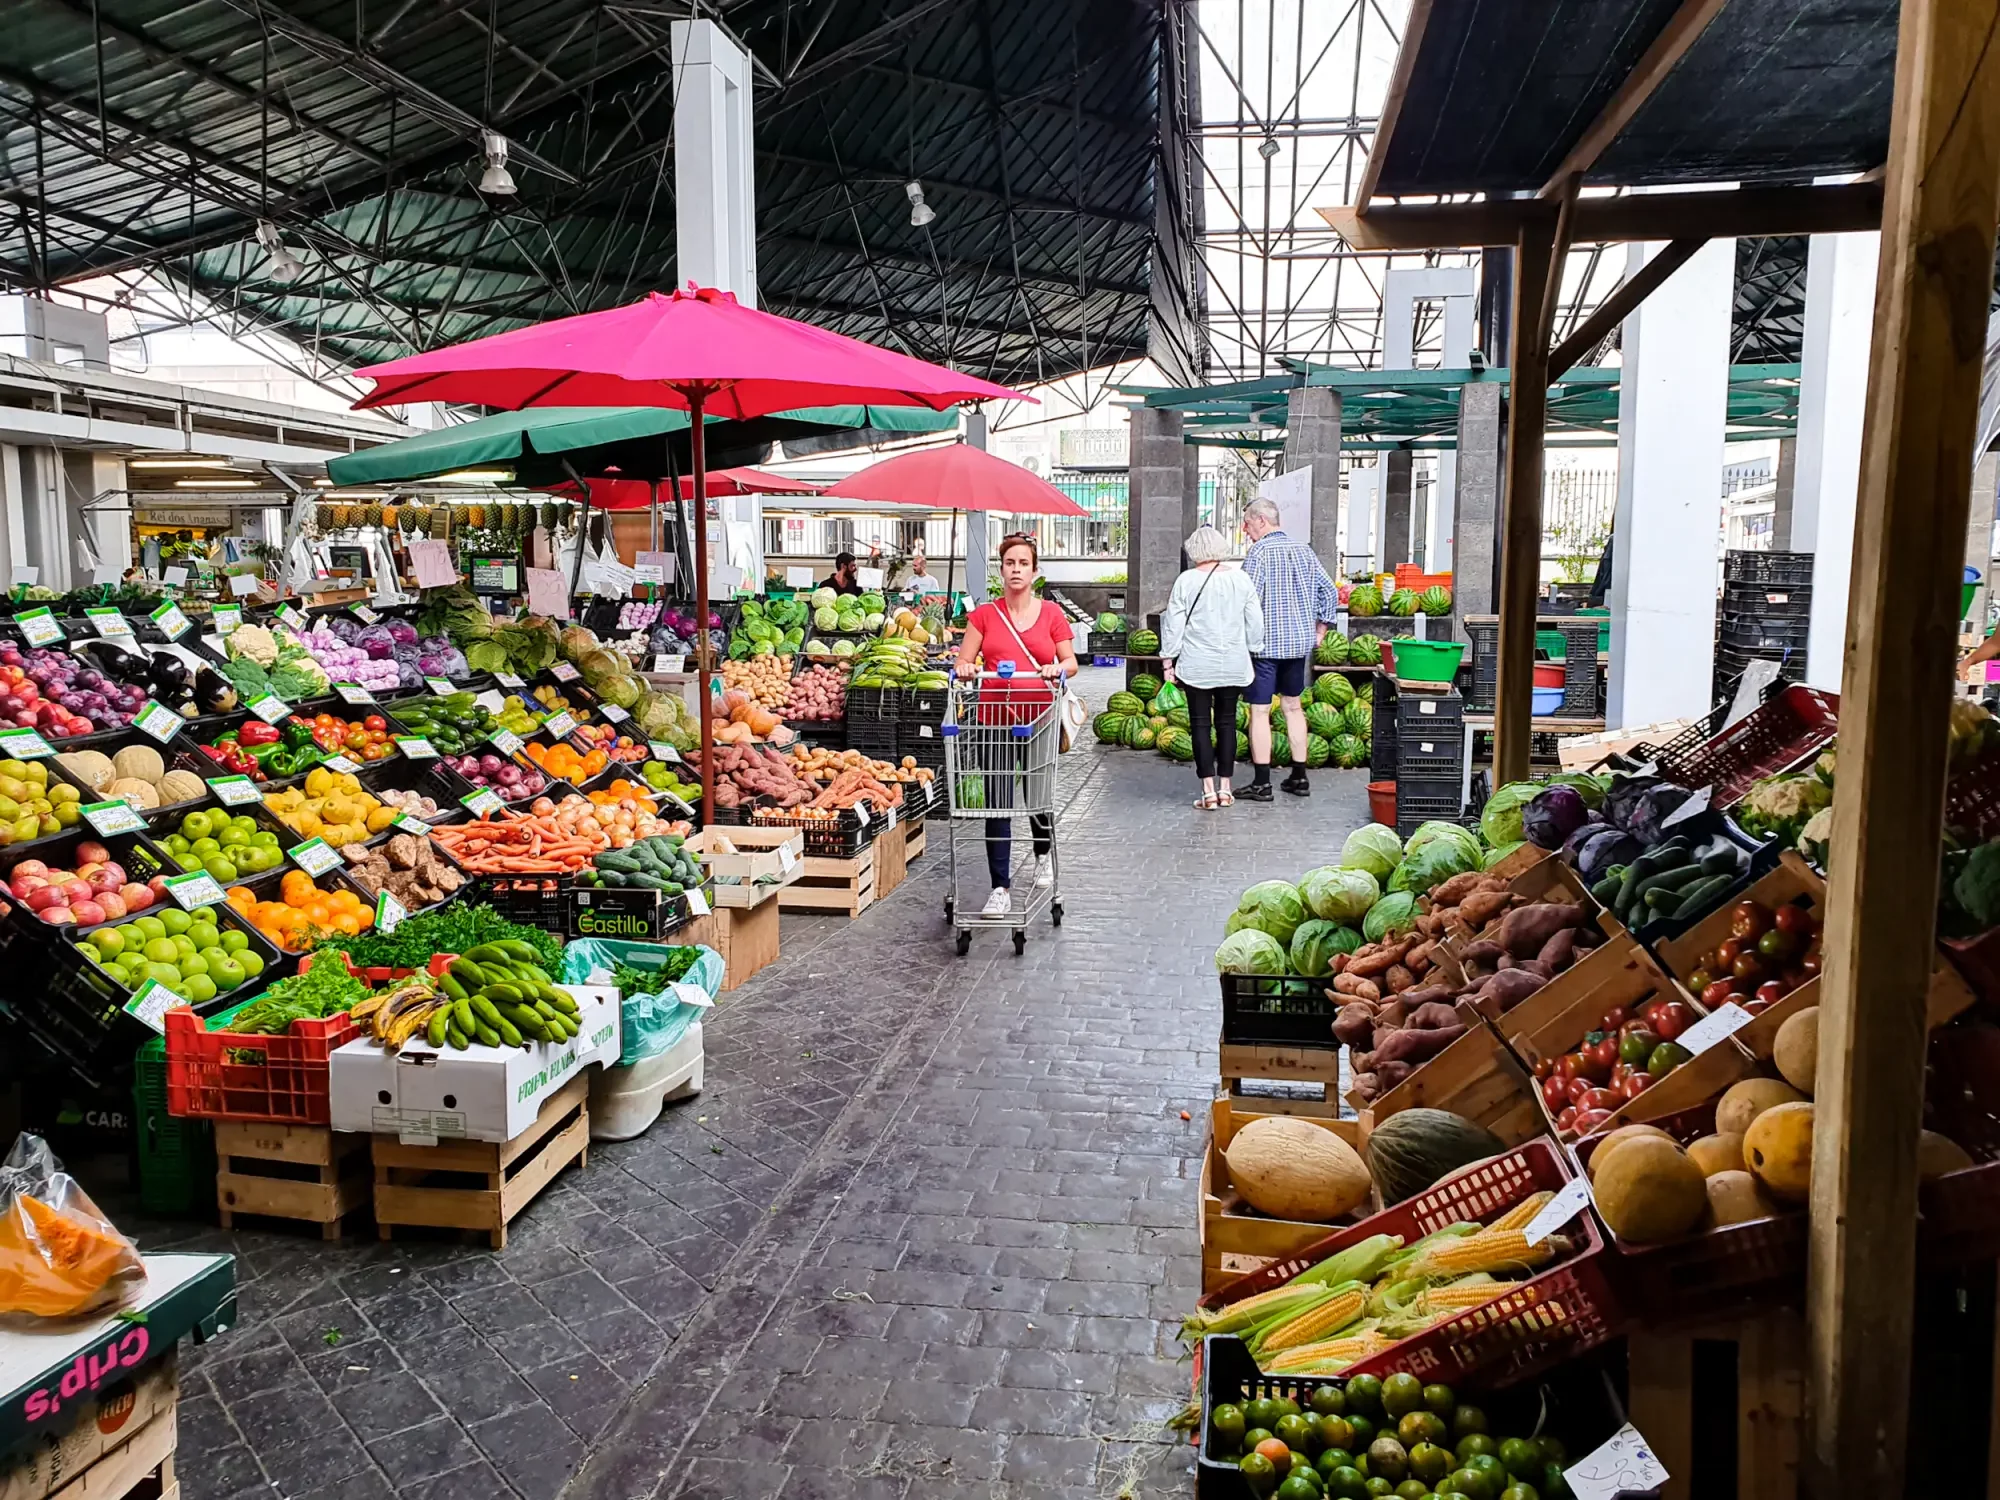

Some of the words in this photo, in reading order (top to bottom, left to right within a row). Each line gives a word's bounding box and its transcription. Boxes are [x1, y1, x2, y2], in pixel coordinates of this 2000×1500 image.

[150, 511, 166, 523] Rei
[168, 512, 185, 523] dos
[578, 913, 648, 934] Castillo
[549, 1049, 576, 1081] SANTA
[518, 1070, 548, 1104] MARIA
[23, 1326, 150, 1422] Crip's
